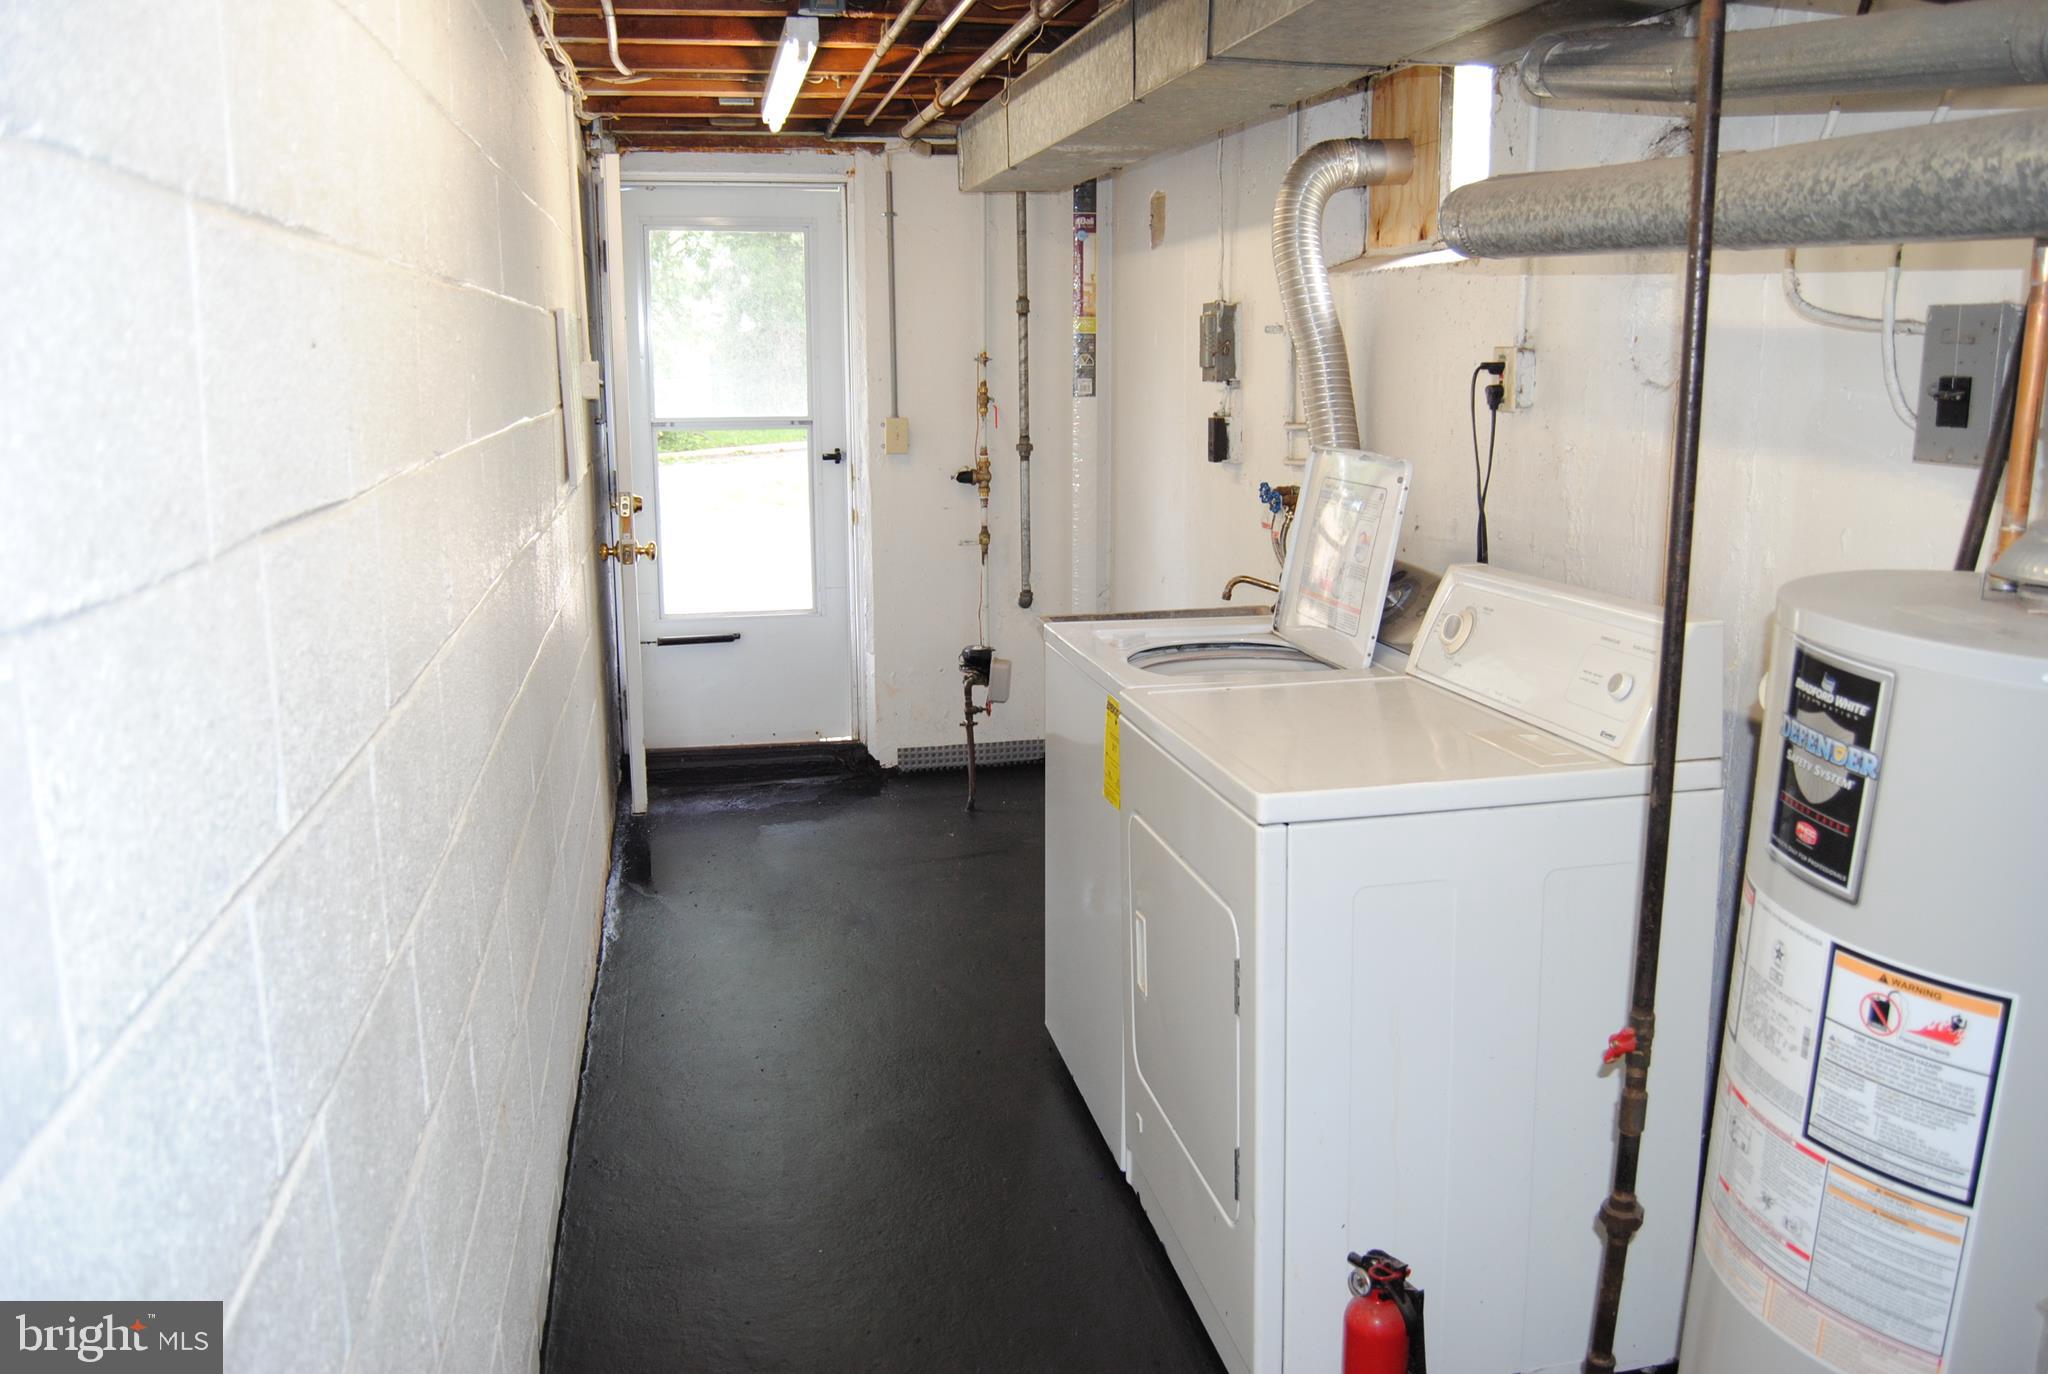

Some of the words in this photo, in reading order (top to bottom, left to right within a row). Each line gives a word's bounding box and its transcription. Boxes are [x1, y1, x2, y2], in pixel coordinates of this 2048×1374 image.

[1835, 695, 1870, 717] WHITE
[1782, 714, 1878, 779] DEFENDER
[1814, 763, 1854, 790] SYSTEM
[1891, 976, 1942, 1001] WARNING
